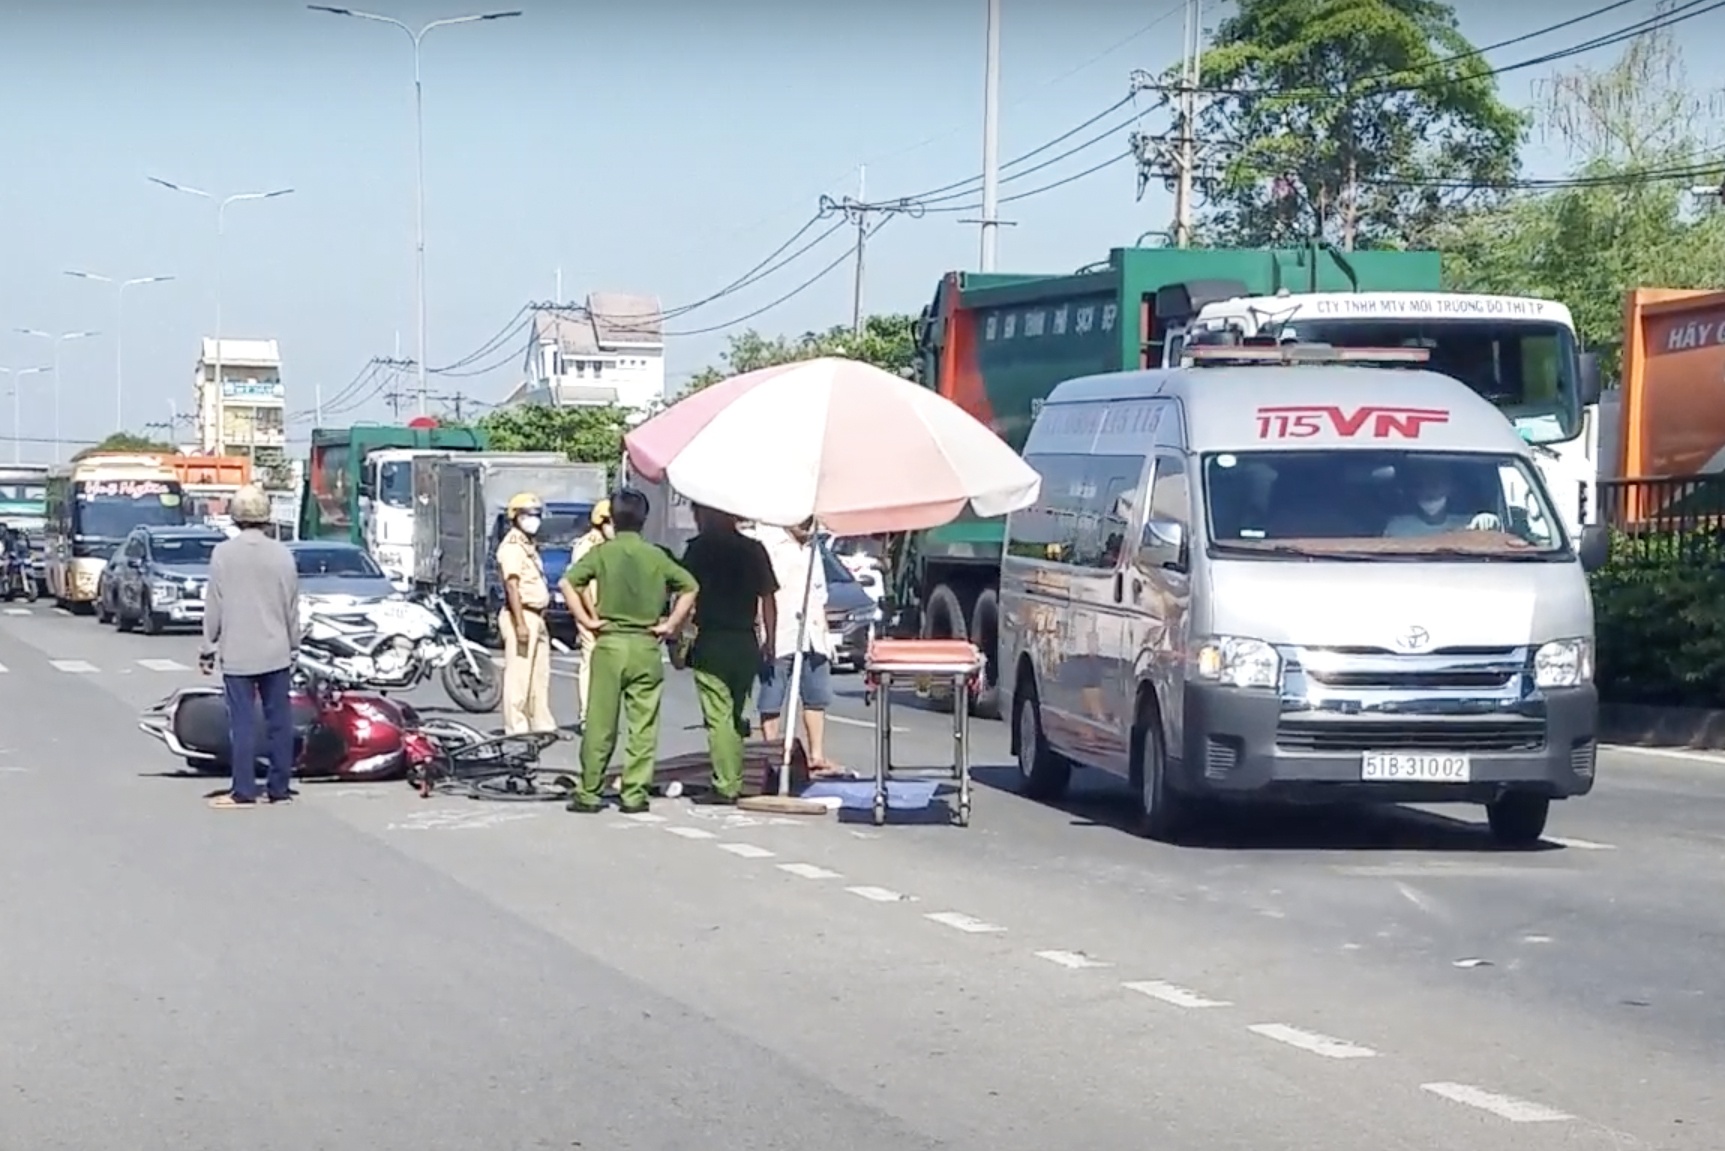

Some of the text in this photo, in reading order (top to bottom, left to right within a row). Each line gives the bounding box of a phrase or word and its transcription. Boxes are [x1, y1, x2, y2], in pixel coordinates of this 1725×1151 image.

[1316, 299, 1339, 313] CTY
[1343, 299, 1377, 313] TNHH
[1380, 299, 1406, 313] MTV
[1668, 317, 1714, 349] HÃY
